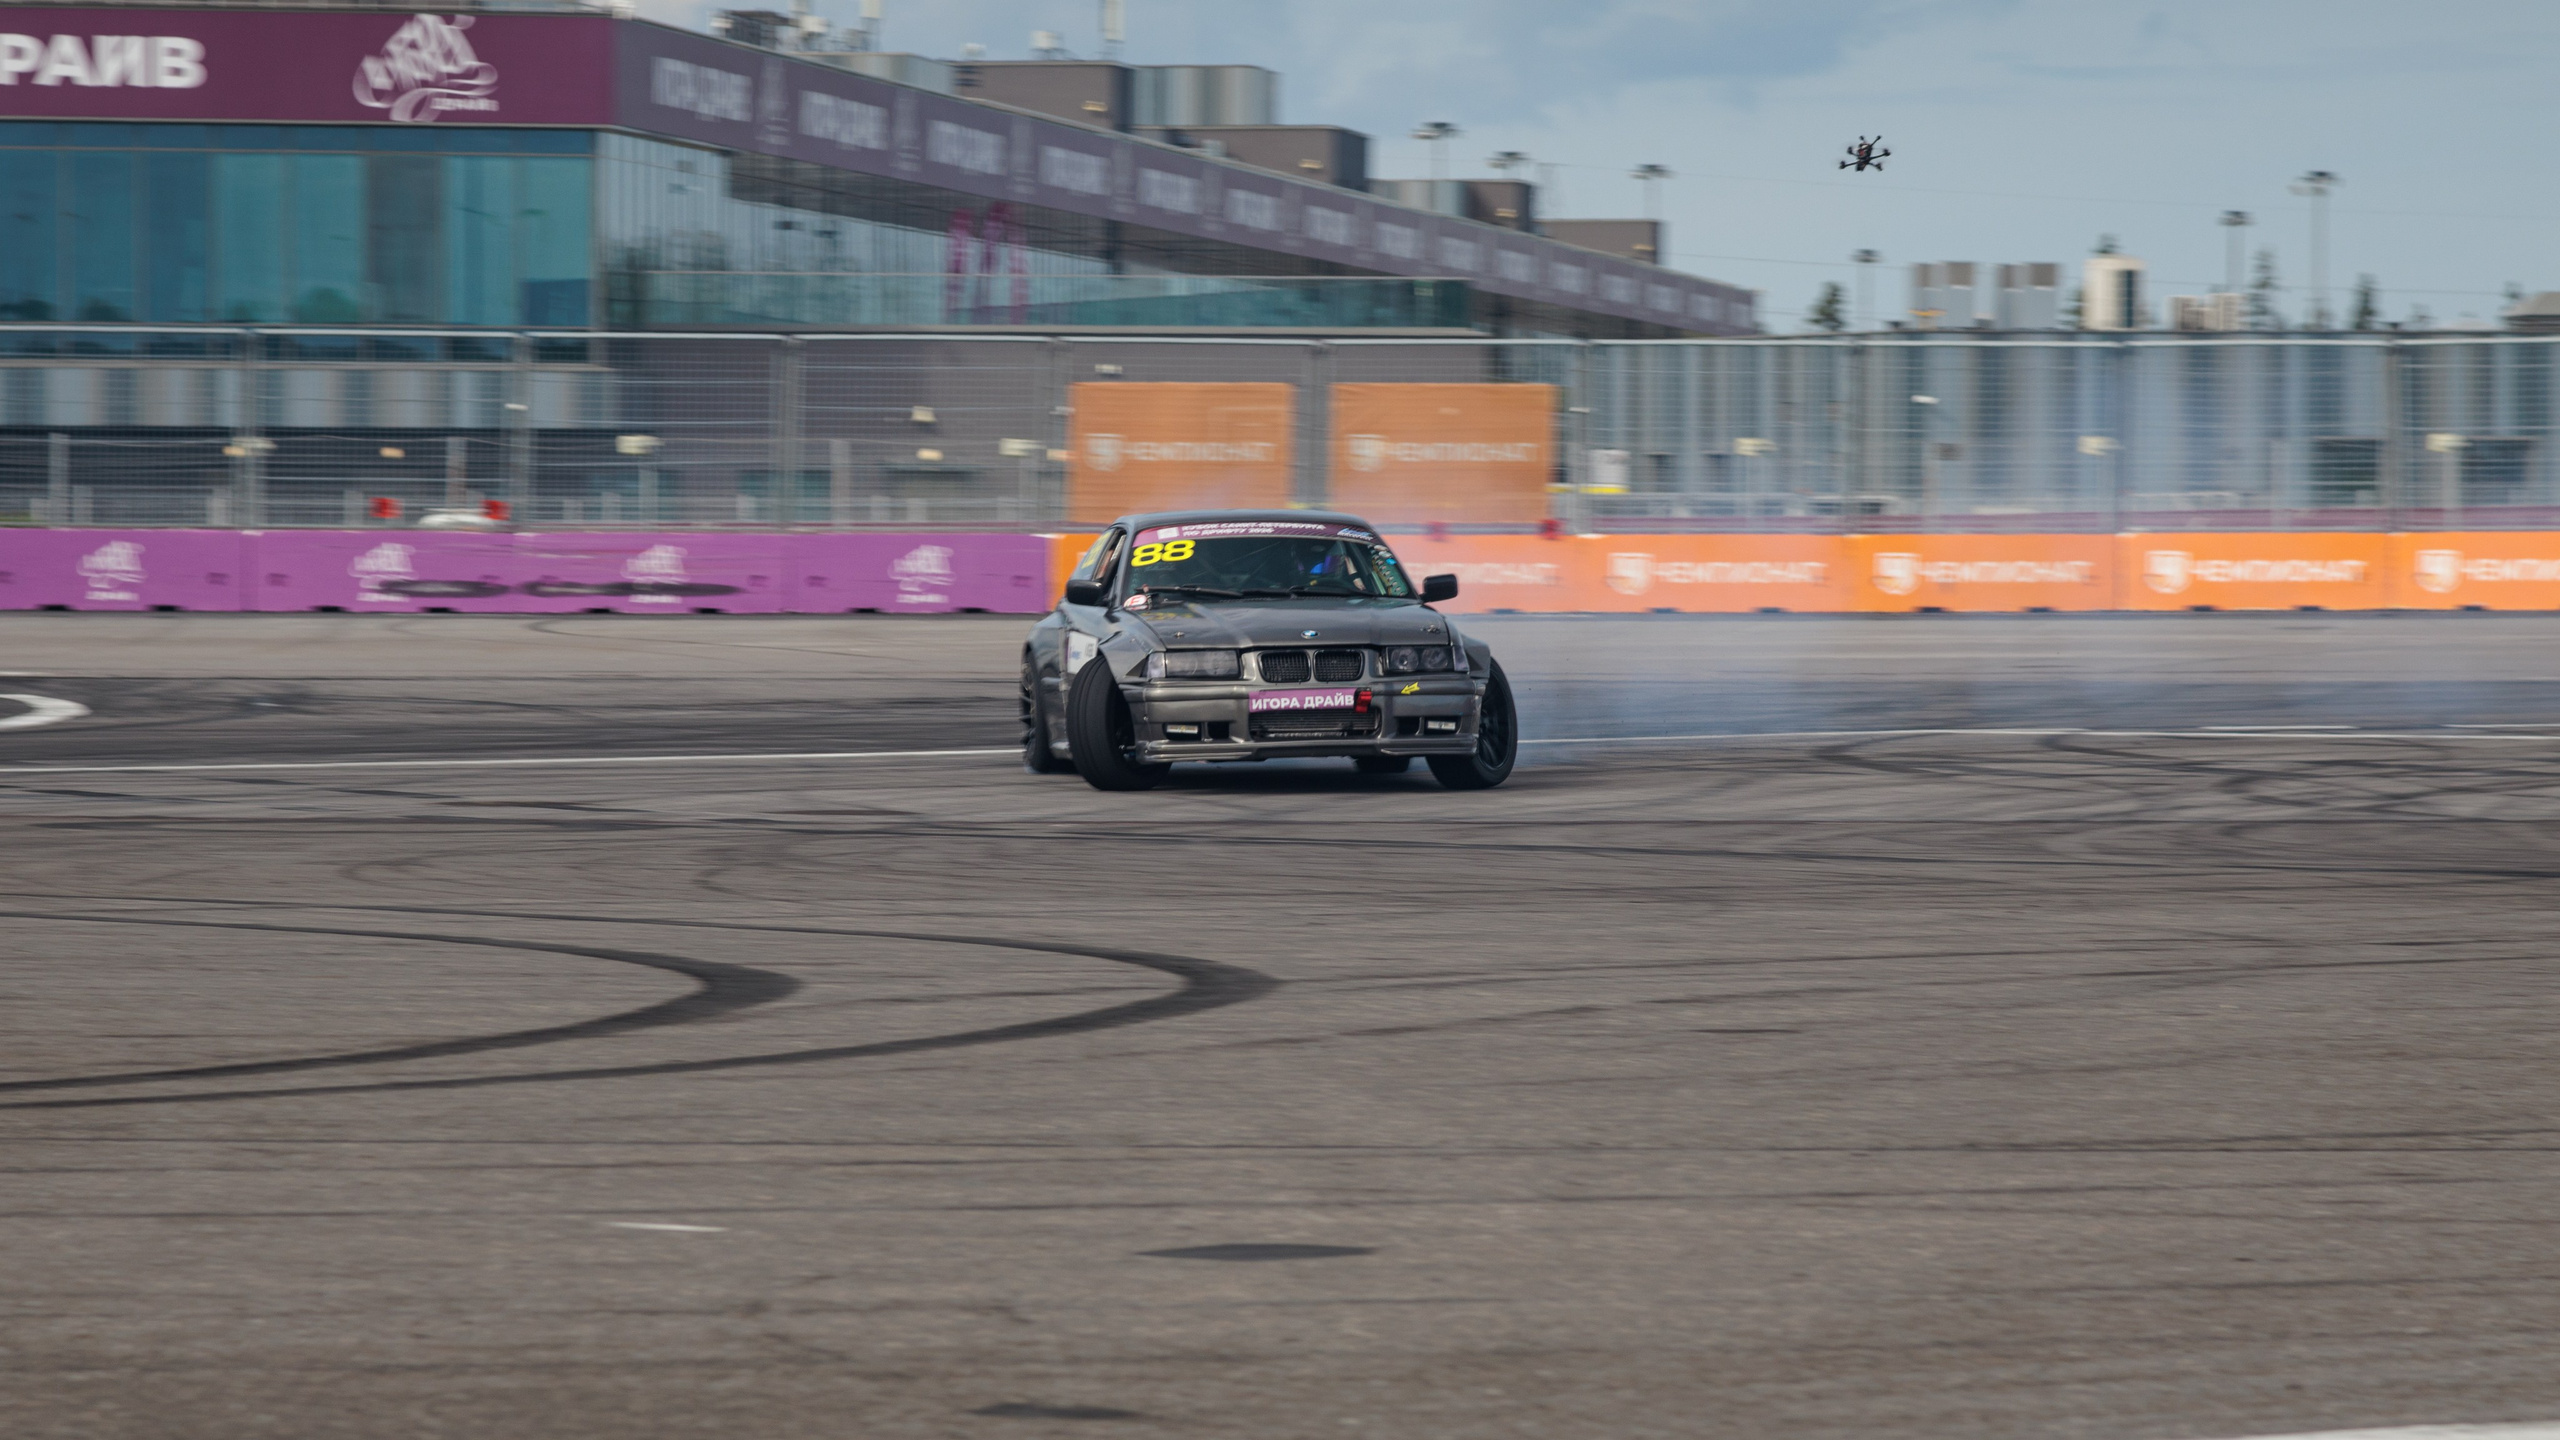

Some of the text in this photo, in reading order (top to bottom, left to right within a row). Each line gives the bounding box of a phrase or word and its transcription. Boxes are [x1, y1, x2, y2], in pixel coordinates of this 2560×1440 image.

[1130, 539, 1196, 567] 88
[1252, 692, 1355, 710] ИГОРА ДРАЙВ
